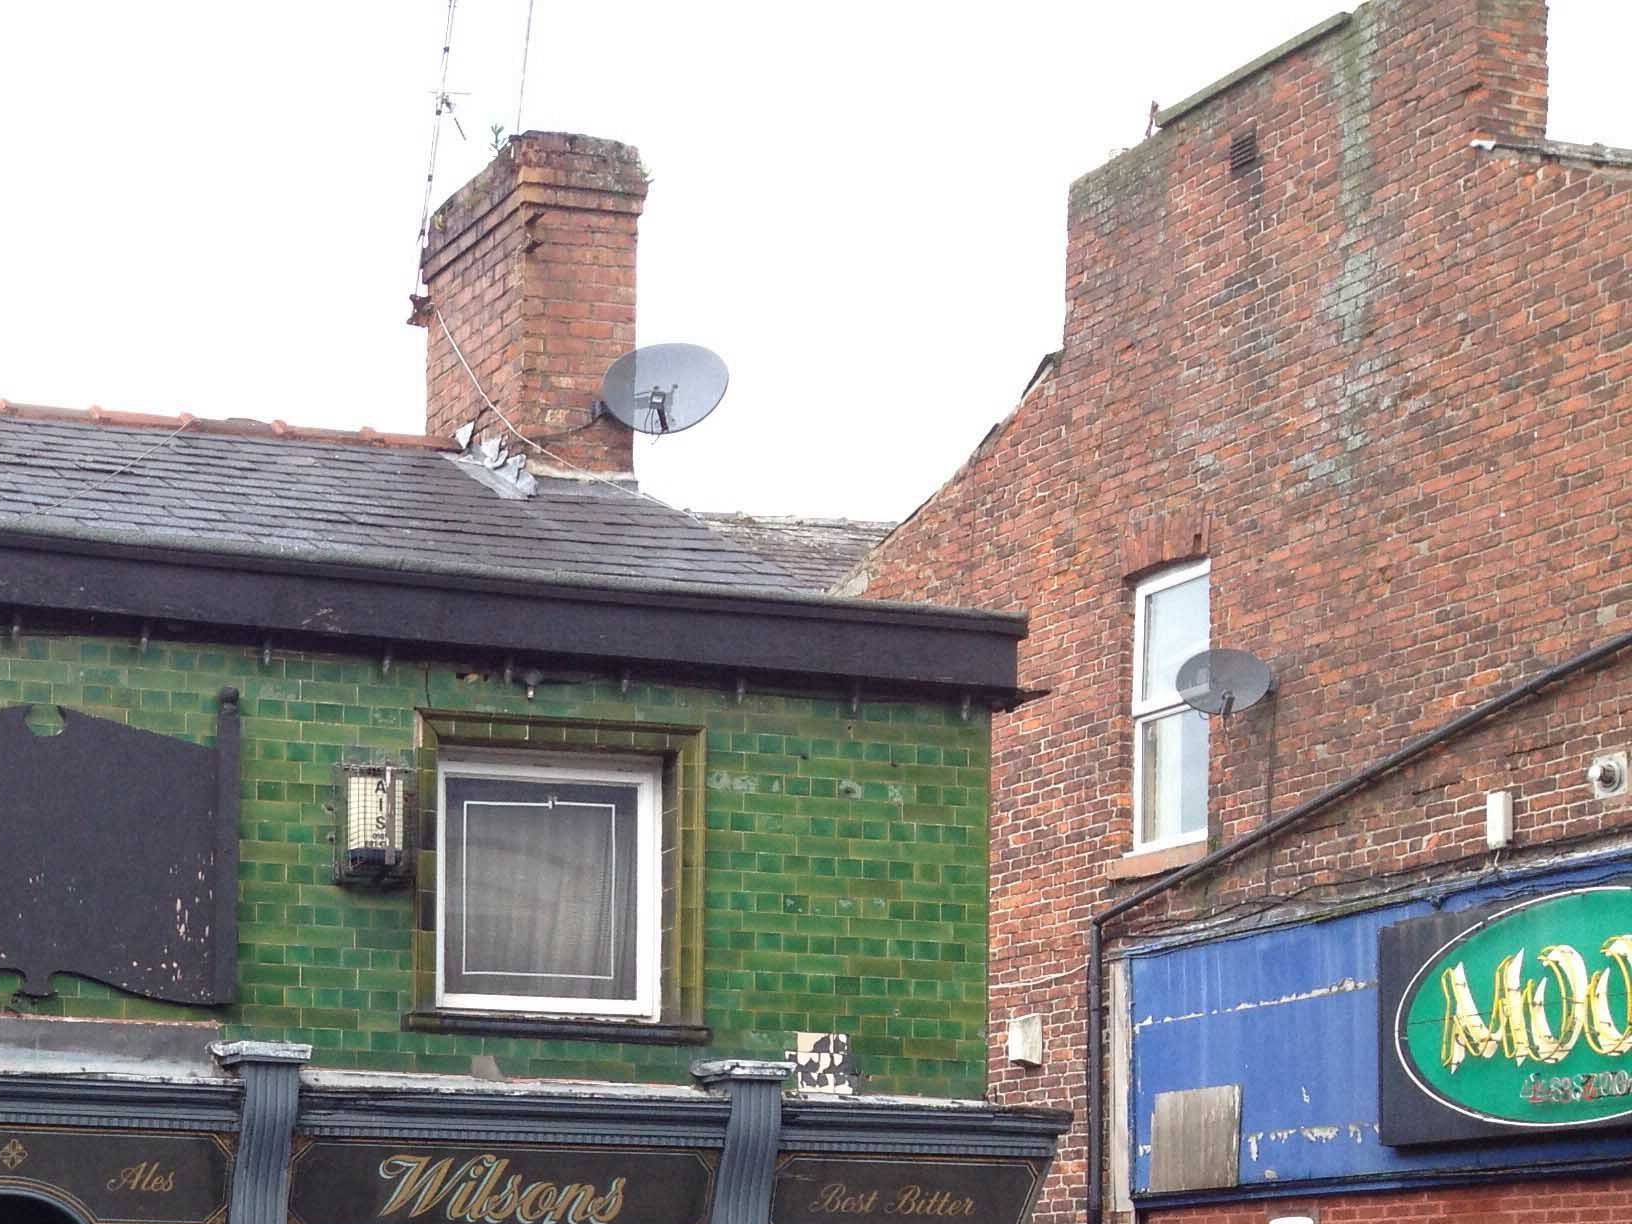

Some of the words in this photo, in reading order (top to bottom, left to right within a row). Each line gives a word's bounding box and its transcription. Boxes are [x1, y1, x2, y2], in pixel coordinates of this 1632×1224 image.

[106, 1161, 175, 1193] Ales
[808, 1184, 879, 1214] Best
[884, 1185, 976, 1216] Bitter
